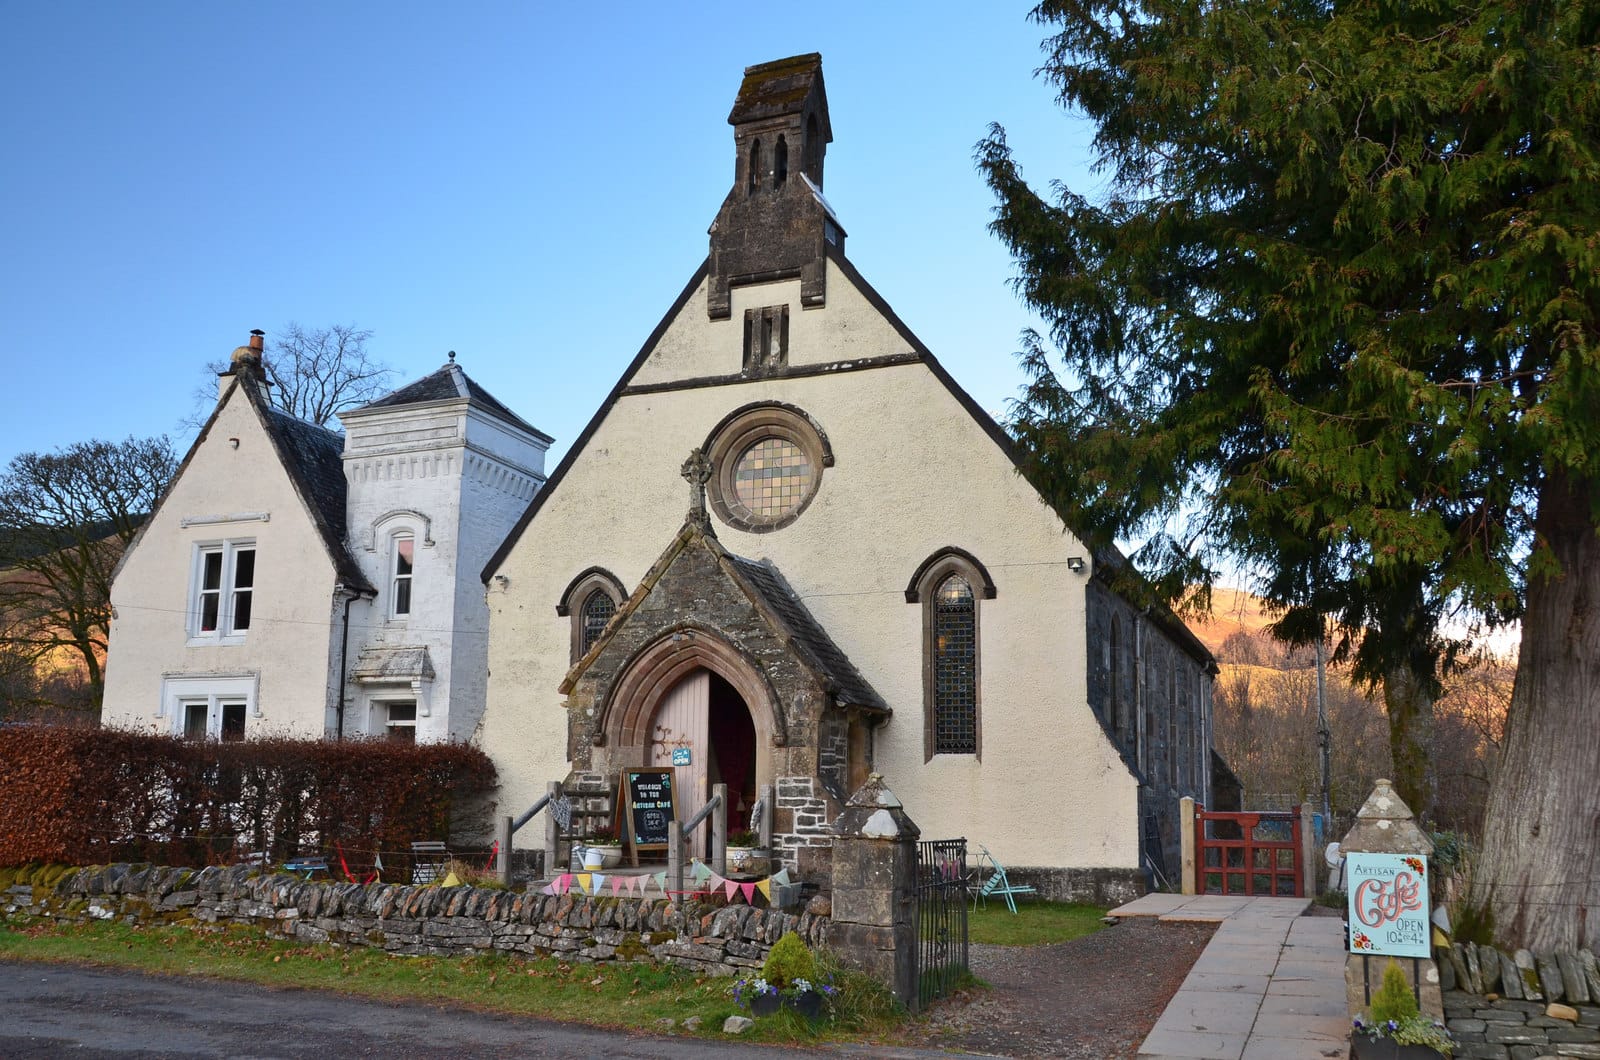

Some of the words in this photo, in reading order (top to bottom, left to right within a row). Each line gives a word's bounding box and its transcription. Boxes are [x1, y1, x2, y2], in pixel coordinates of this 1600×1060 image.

[1354, 864, 1395, 876] ARTISAN
[1354, 871, 1422, 928] Café
[1396, 917, 1424, 932] OPEN
